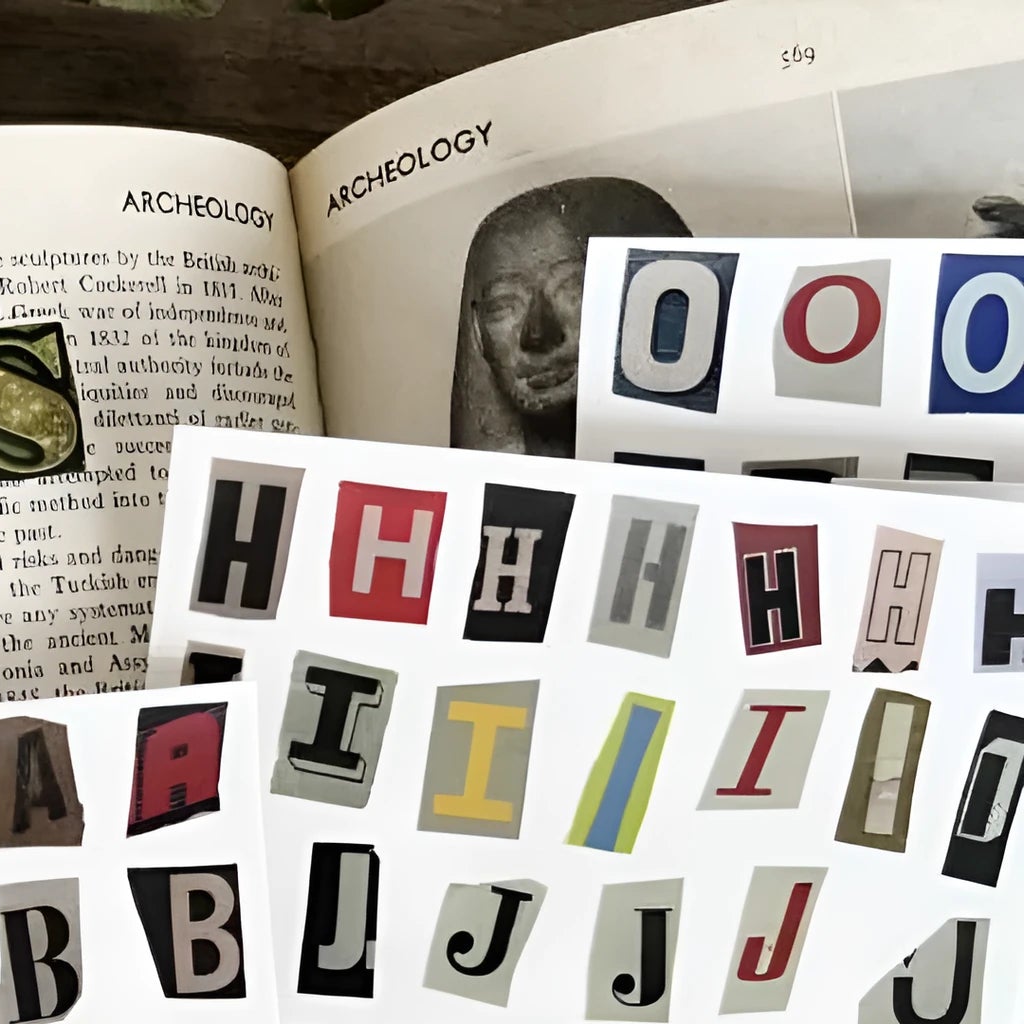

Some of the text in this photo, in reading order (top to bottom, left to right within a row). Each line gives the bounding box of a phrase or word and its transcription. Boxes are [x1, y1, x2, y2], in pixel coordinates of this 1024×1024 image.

[122, 190, 274, 231] ARCHEOLOGY
[326, 121, 493, 217] ARCHEOLOGY
[783, 275, 880, 364] O
[198, 480, 930, 645] H H H H H H
[10, 728, 67, 835] A
[135, 711, 221, 821] A
[289, 666, 382, 779] I
[433, 702, 528, 822] I
[716, 706, 807, 796] I
[1, 905, 72, 1024] B
[170, 874, 238, 993] B
[317, 853, 375, 969] J
[447, 886, 533, 977] J
[612, 908, 672, 1007] J
[737, 883, 812, 982] J
